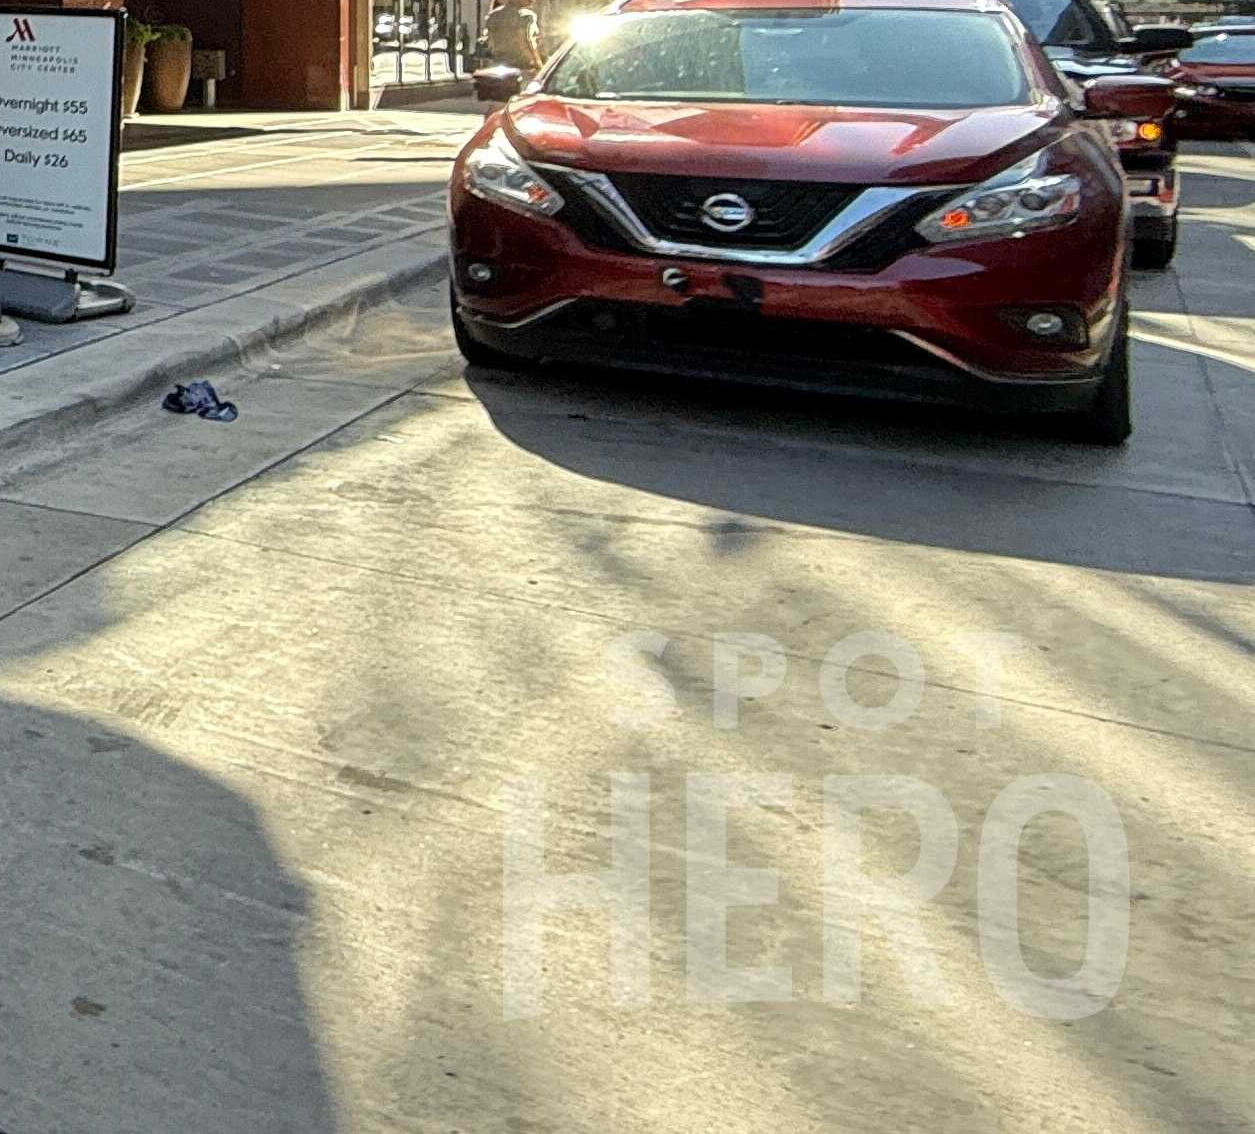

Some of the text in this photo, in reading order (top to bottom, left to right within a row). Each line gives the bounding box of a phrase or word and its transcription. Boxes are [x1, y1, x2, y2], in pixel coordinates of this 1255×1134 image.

[11, 44, 61, 54] MARRIOTT
[10, 54, 79, 66] MINNEAPOLIS
[9, 63, 76, 74] CITY CENTER
[63, 99, 89, 115] $55
[62, 127, 88, 144] $65
[4, 148, 69, 169] Daily $26
